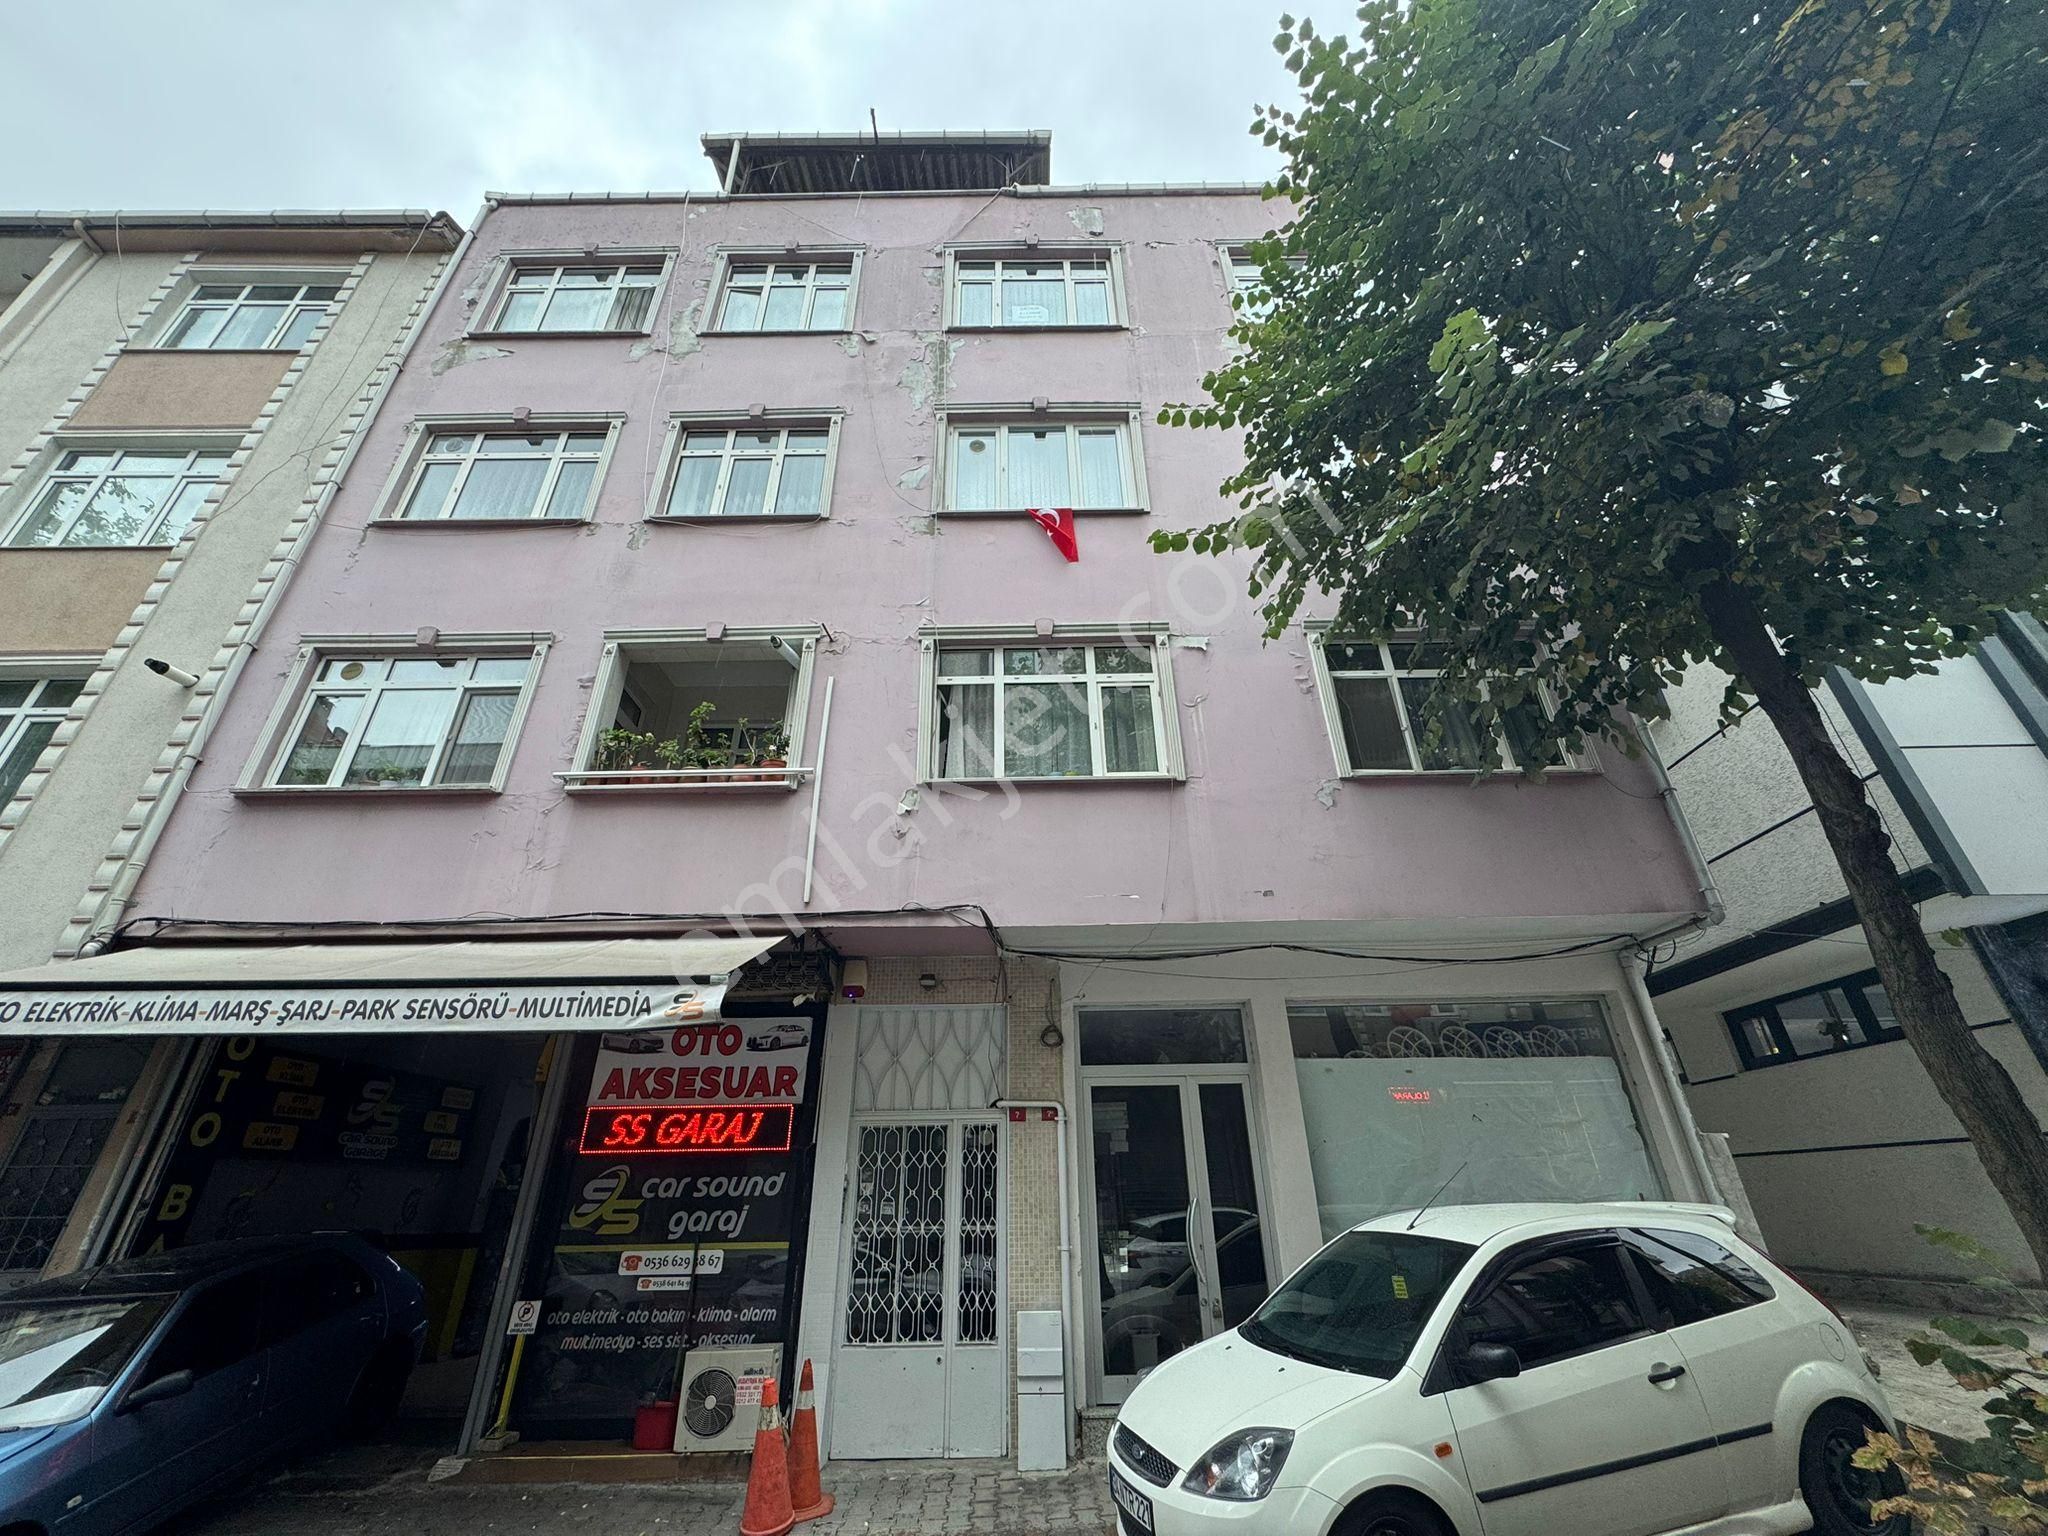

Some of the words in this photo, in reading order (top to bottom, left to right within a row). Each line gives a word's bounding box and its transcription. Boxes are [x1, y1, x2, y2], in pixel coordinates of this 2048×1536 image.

[671, 1024, 743, 1057] OTO
[598, 1066, 799, 1100] AKSESUAR
[604, 1113, 652, 1145] SS
[656, 1111, 765, 1144] GARAJ
[641, 1175, 694, 1200] car
[693, 1171, 787, 1198] sound
[667, 1204, 750, 1241] garaj
[644, 1254, 669, 1270] 0536
[671, 1254, 691, 1270] 629
[707, 1254, 721, 1269] 67
[547, 1310, 570, 1325] oto
[572, 1308, 620, 1325] elektrik
[626, 1309, 649, 1324] oto
[697, 1305, 733, 1322] klima
[739, 1306, 777, 1322] alarm
[641, 1334, 665, 1349] ses
